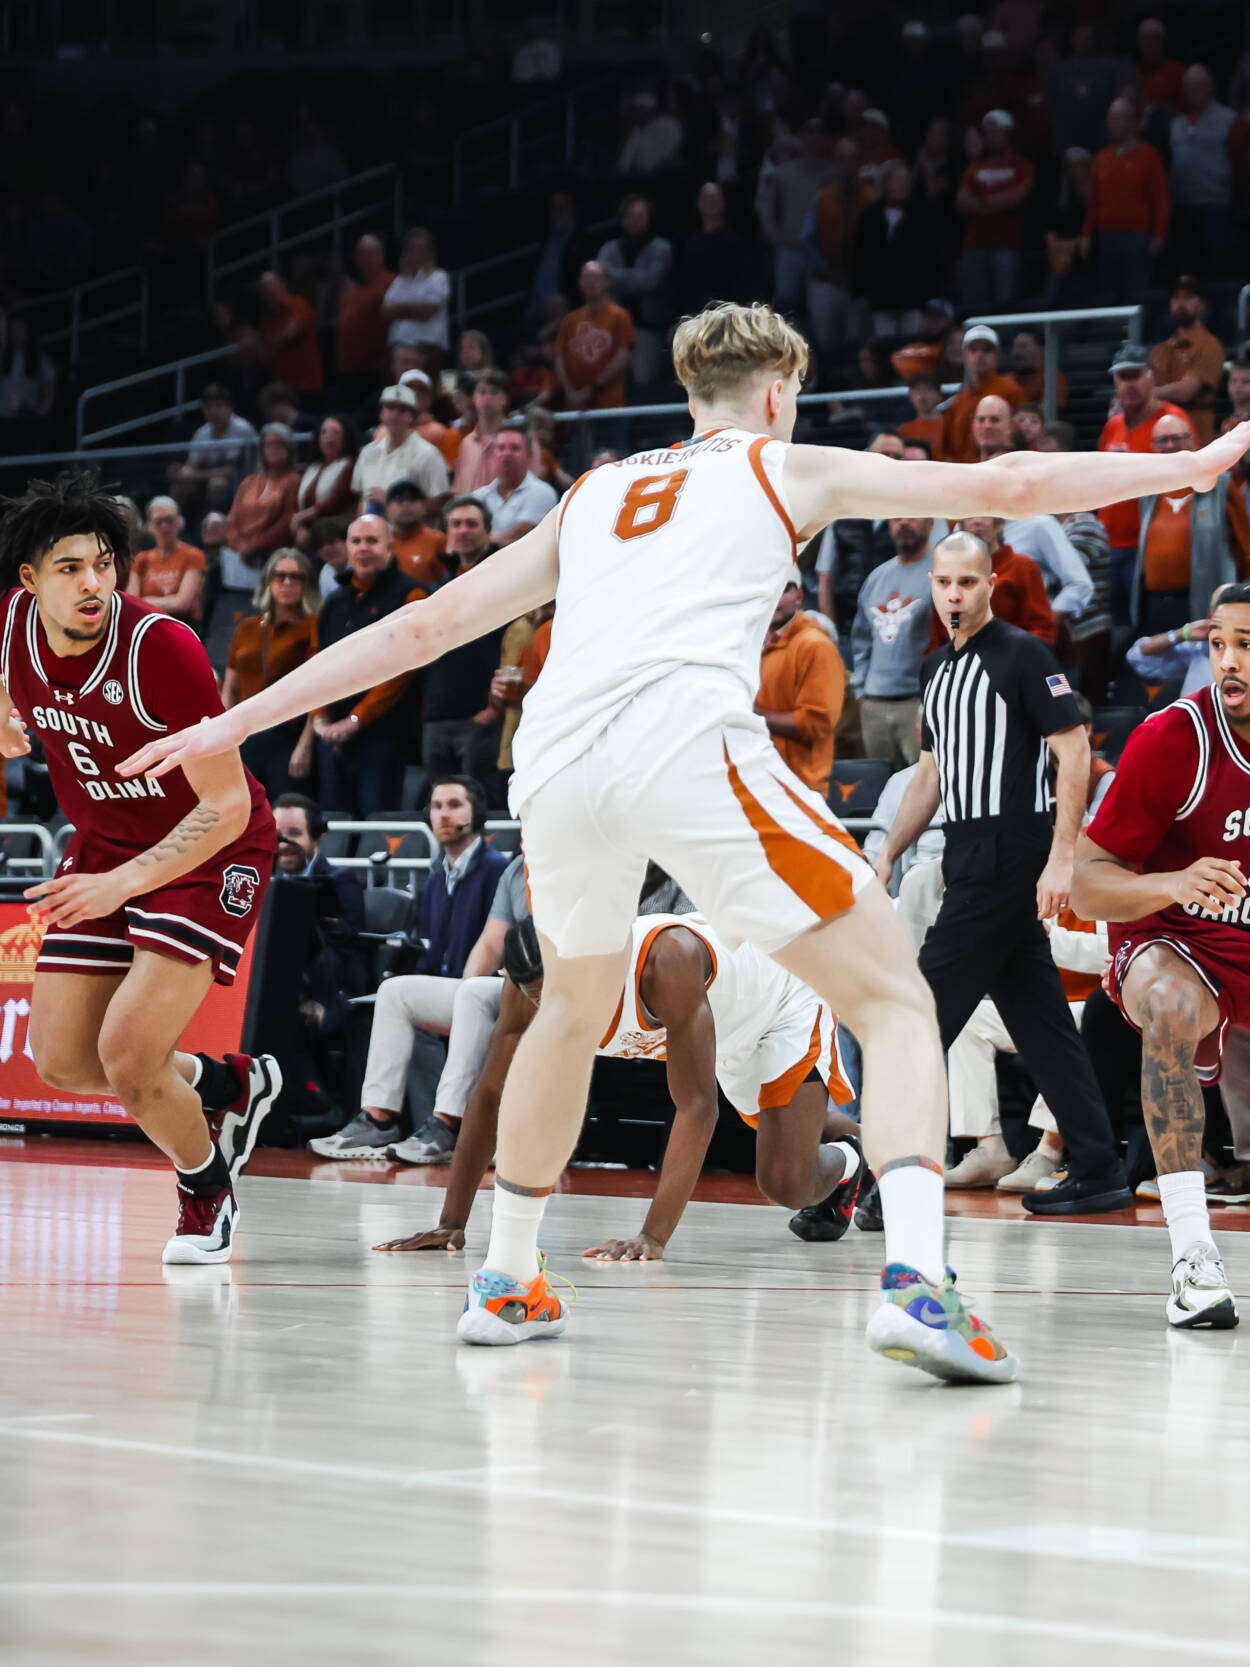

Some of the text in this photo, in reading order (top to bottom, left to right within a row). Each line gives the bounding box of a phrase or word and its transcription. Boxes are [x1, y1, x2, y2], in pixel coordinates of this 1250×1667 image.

[610, 467, 691, 543] 8
[103, 681, 124, 704] SEC
[32, 706, 115, 748] SOUTH
[67, 741, 101, 776] 6
[77, 776, 166, 801] OLINA
